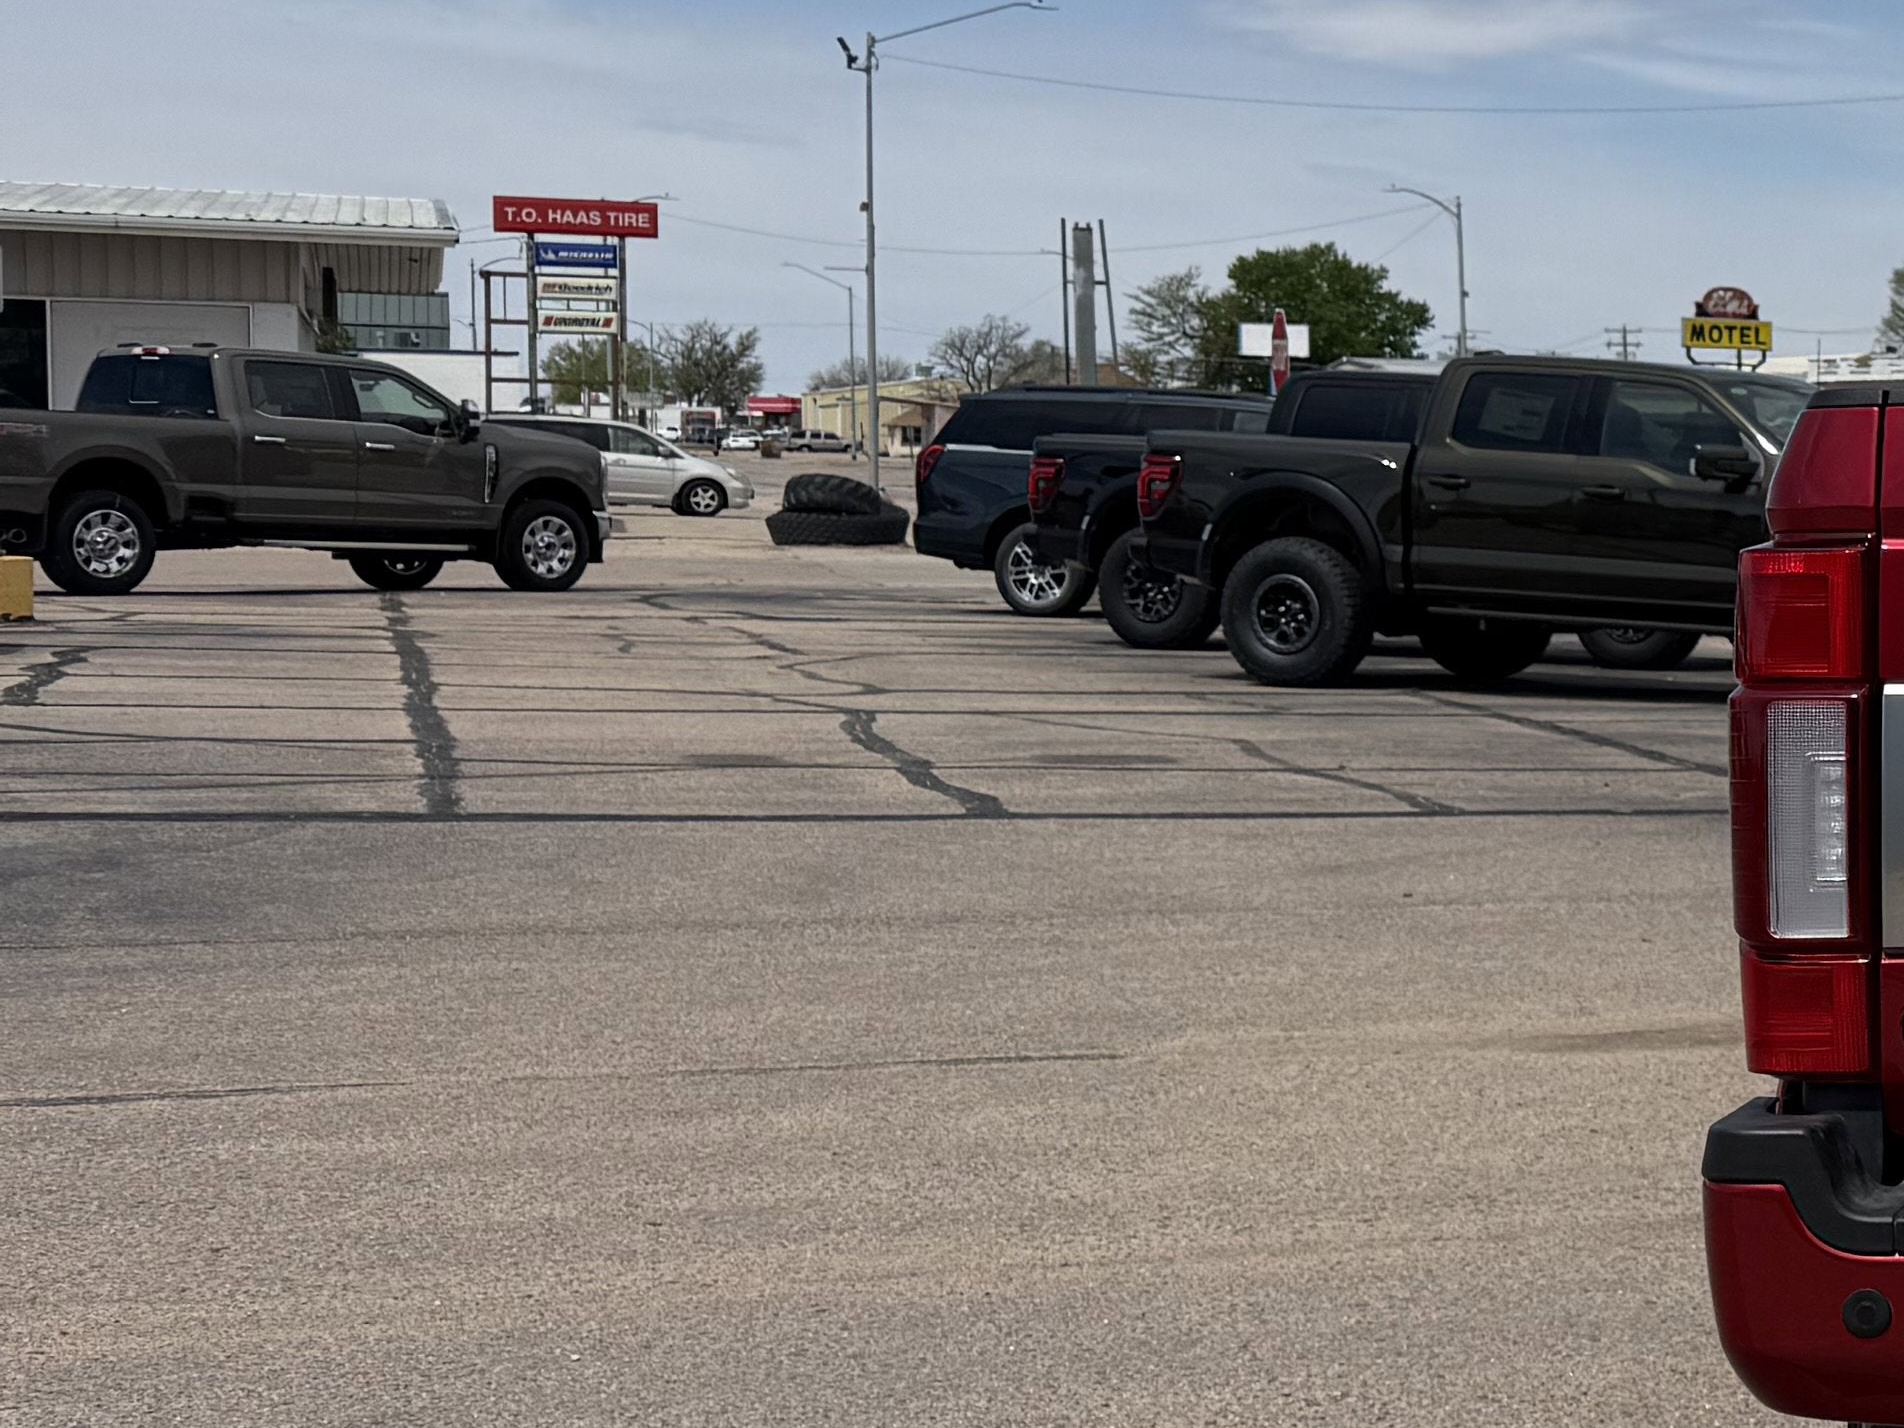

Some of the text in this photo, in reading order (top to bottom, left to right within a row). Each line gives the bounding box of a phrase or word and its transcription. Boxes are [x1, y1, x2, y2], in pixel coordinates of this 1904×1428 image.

[504, 207, 651, 228] T.O. HAAS TIRE
[1690, 323, 1767, 345] MOTEL
